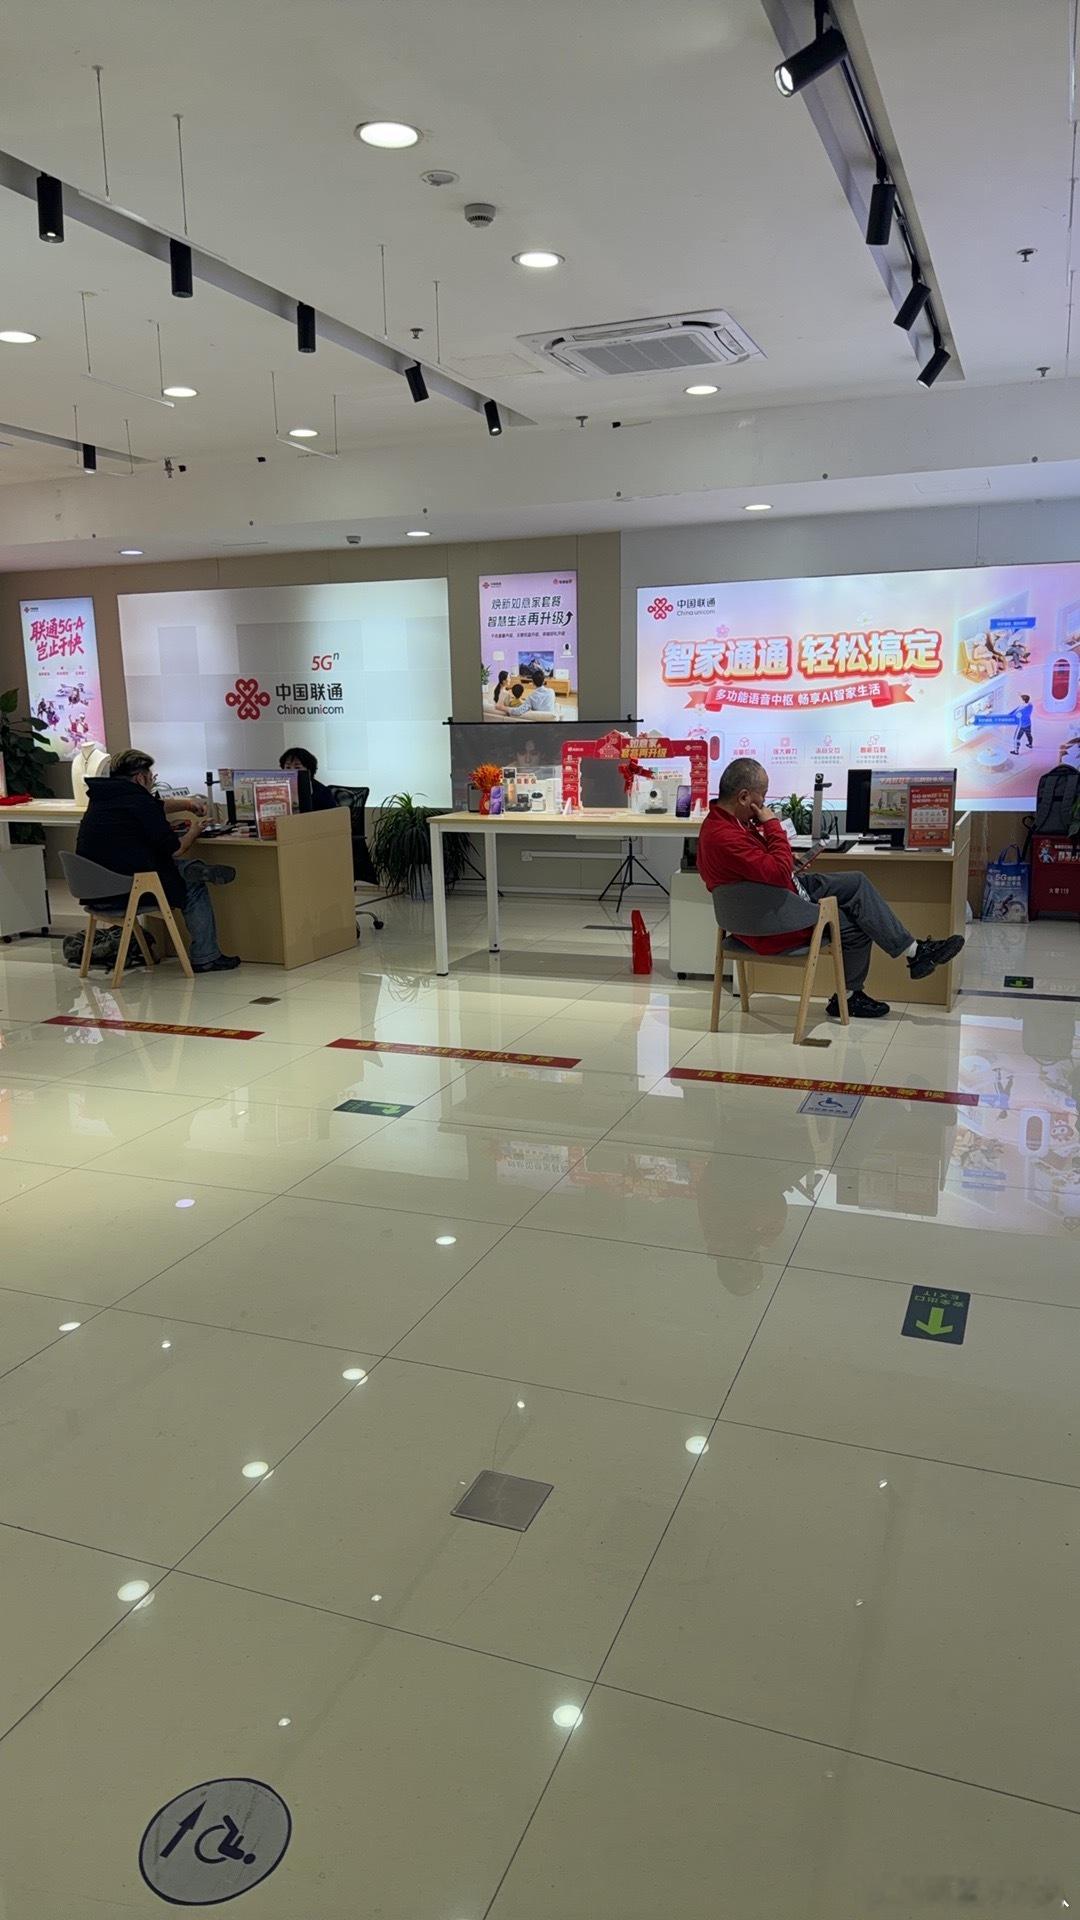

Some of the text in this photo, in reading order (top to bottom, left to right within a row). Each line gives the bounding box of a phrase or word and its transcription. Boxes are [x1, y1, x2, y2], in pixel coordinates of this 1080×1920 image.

[491, 596, 561, 610] 焕新如意家套餐
[677, 597, 716, 609] 中国联通
[487, 611, 564, 628] 智慧生活再升级
[677, 609, 693, 617] China
[36, 633, 85, 662] 岂止于快
[662, 630, 941, 682] 智家通通 轻松搞定
[275, 683, 343, 701] 中国联通
[715, 682, 881, 707] 多功能语音中枢 畅享AI智家生活
[276, 704, 344, 715] China unicom
